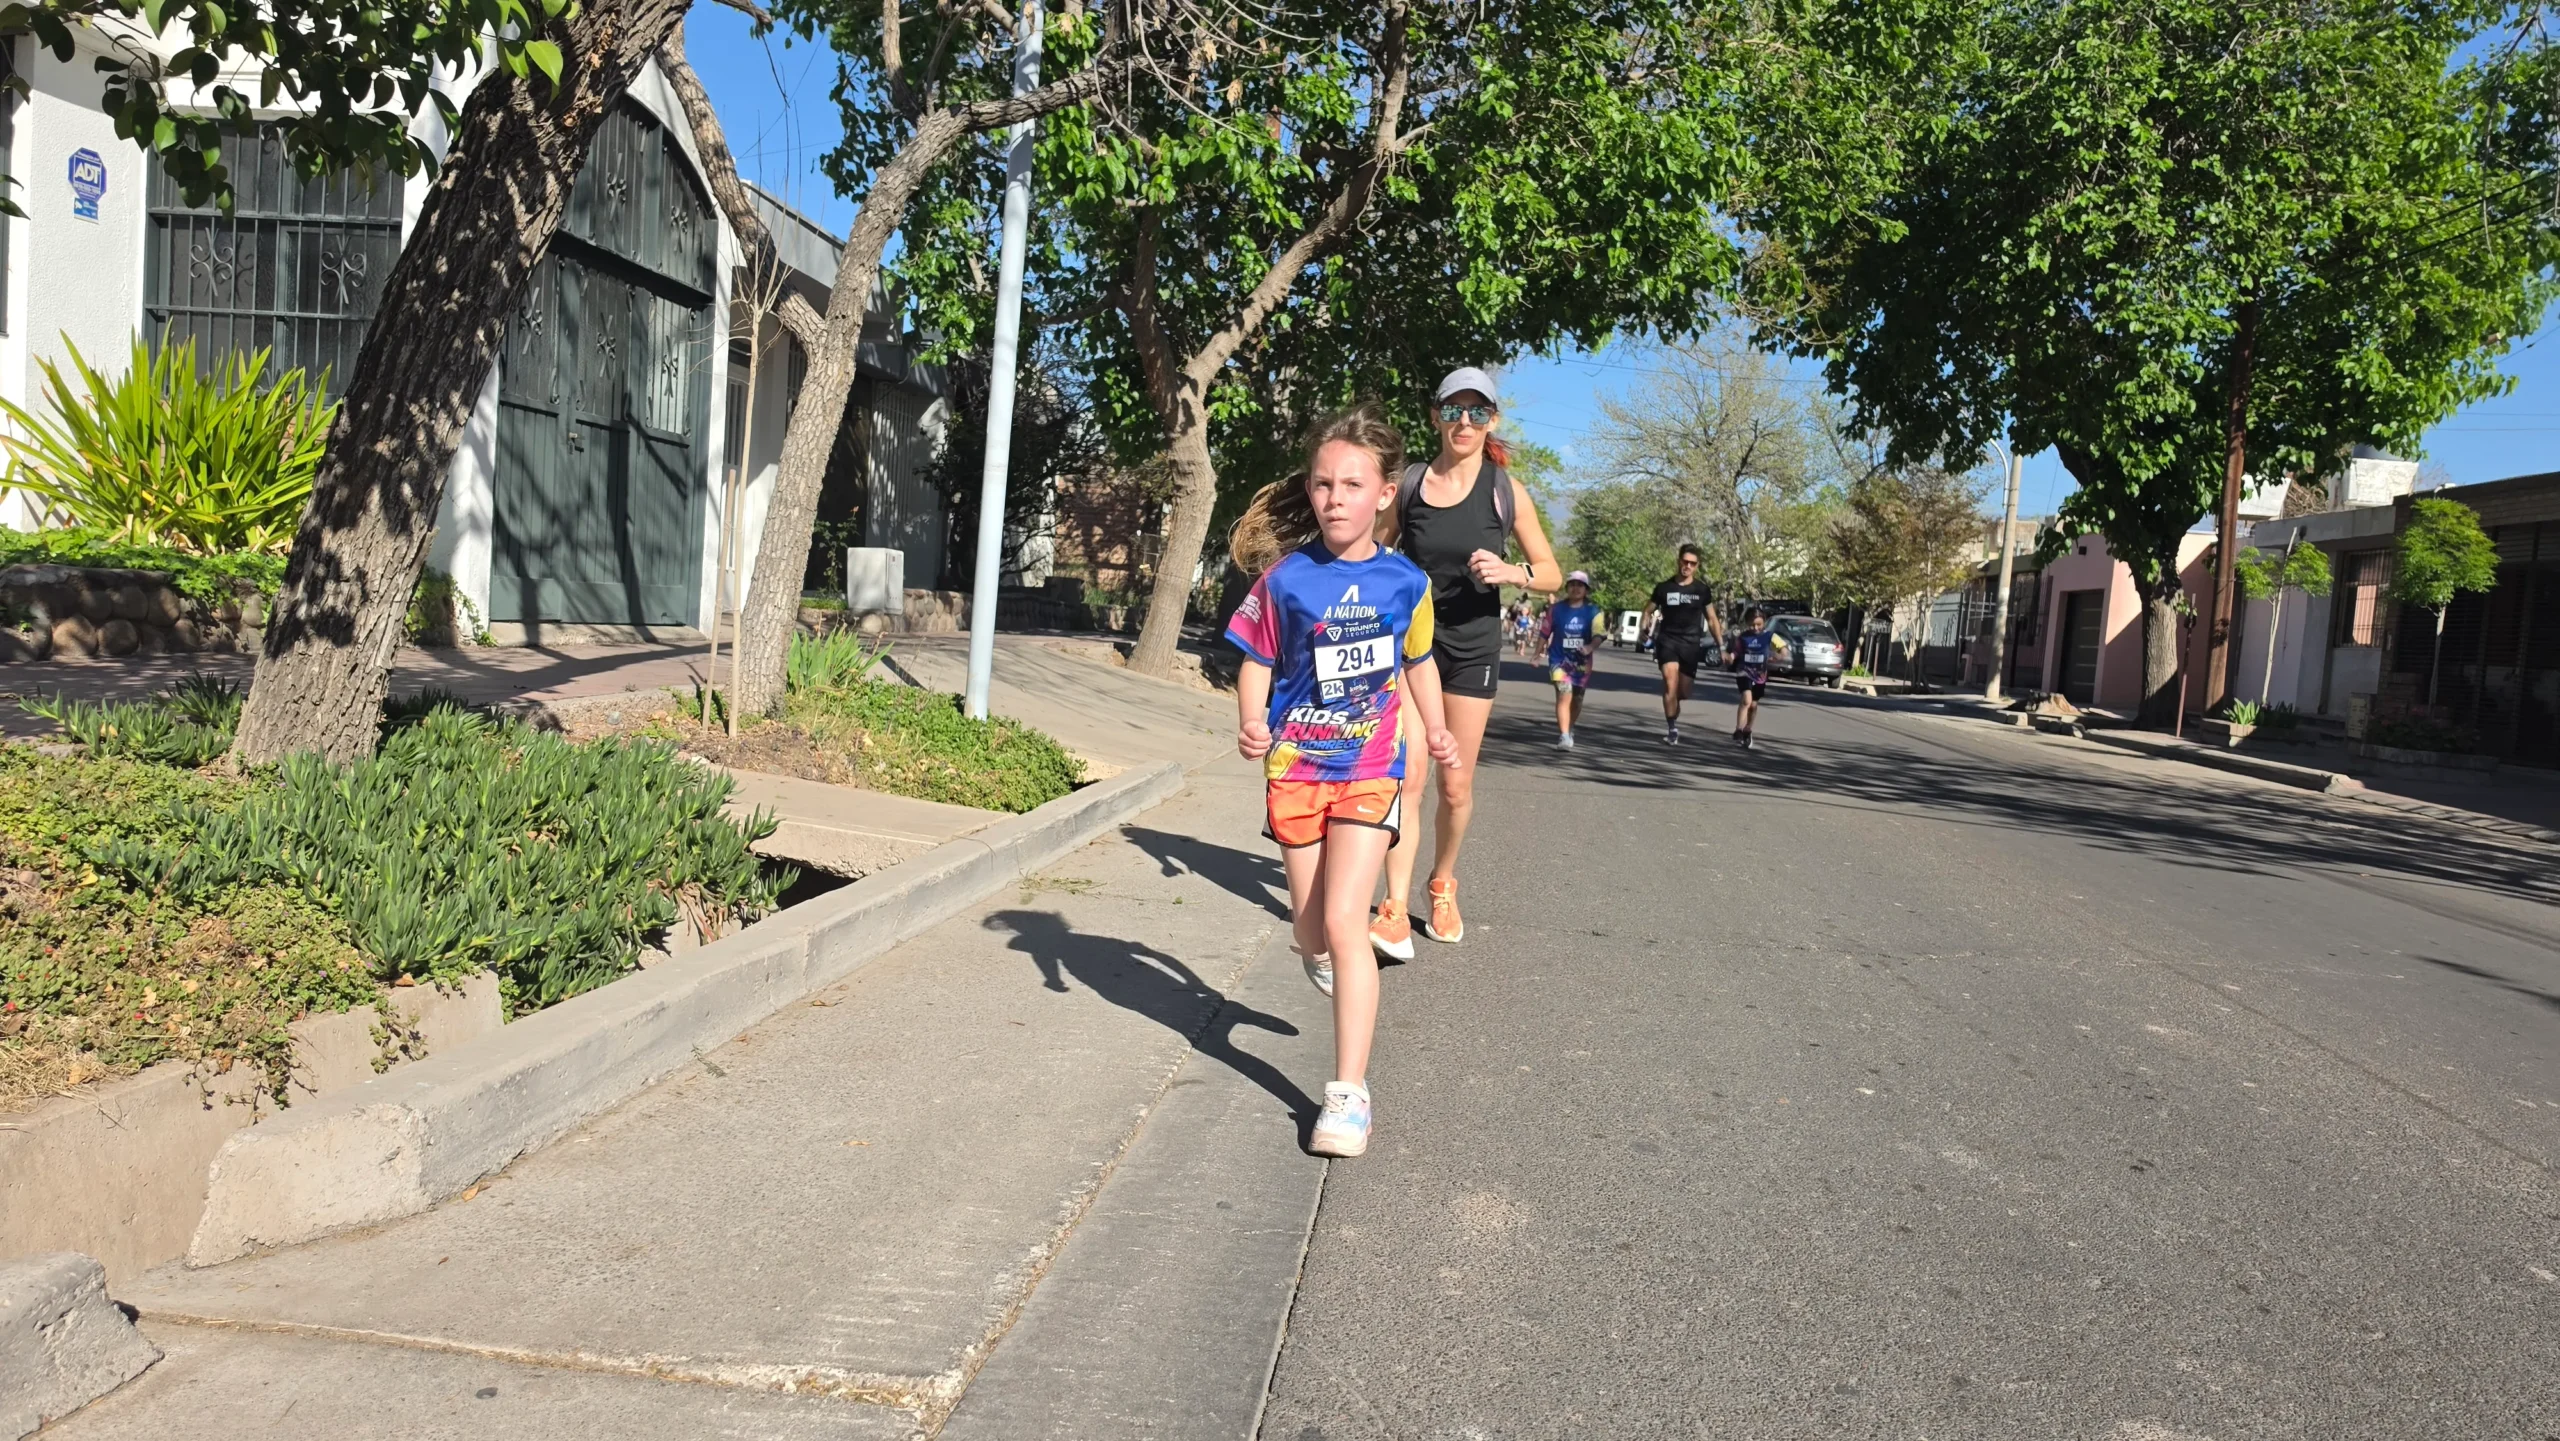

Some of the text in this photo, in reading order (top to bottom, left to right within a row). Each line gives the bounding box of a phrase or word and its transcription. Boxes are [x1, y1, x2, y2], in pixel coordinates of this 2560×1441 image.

[75, 162, 101, 184] ADT
[1323, 606, 1332, 619] A
[1344, 623, 1380, 633] TRIUNFO
[1345, 628, 1379, 637] SEGUROS
[1337, 644, 1375, 672] 294
[1287, 707, 1349, 724] KIDS
[1280, 718, 1381, 740] RUNNING
[1299, 738, 1364, 749] DORREGO
